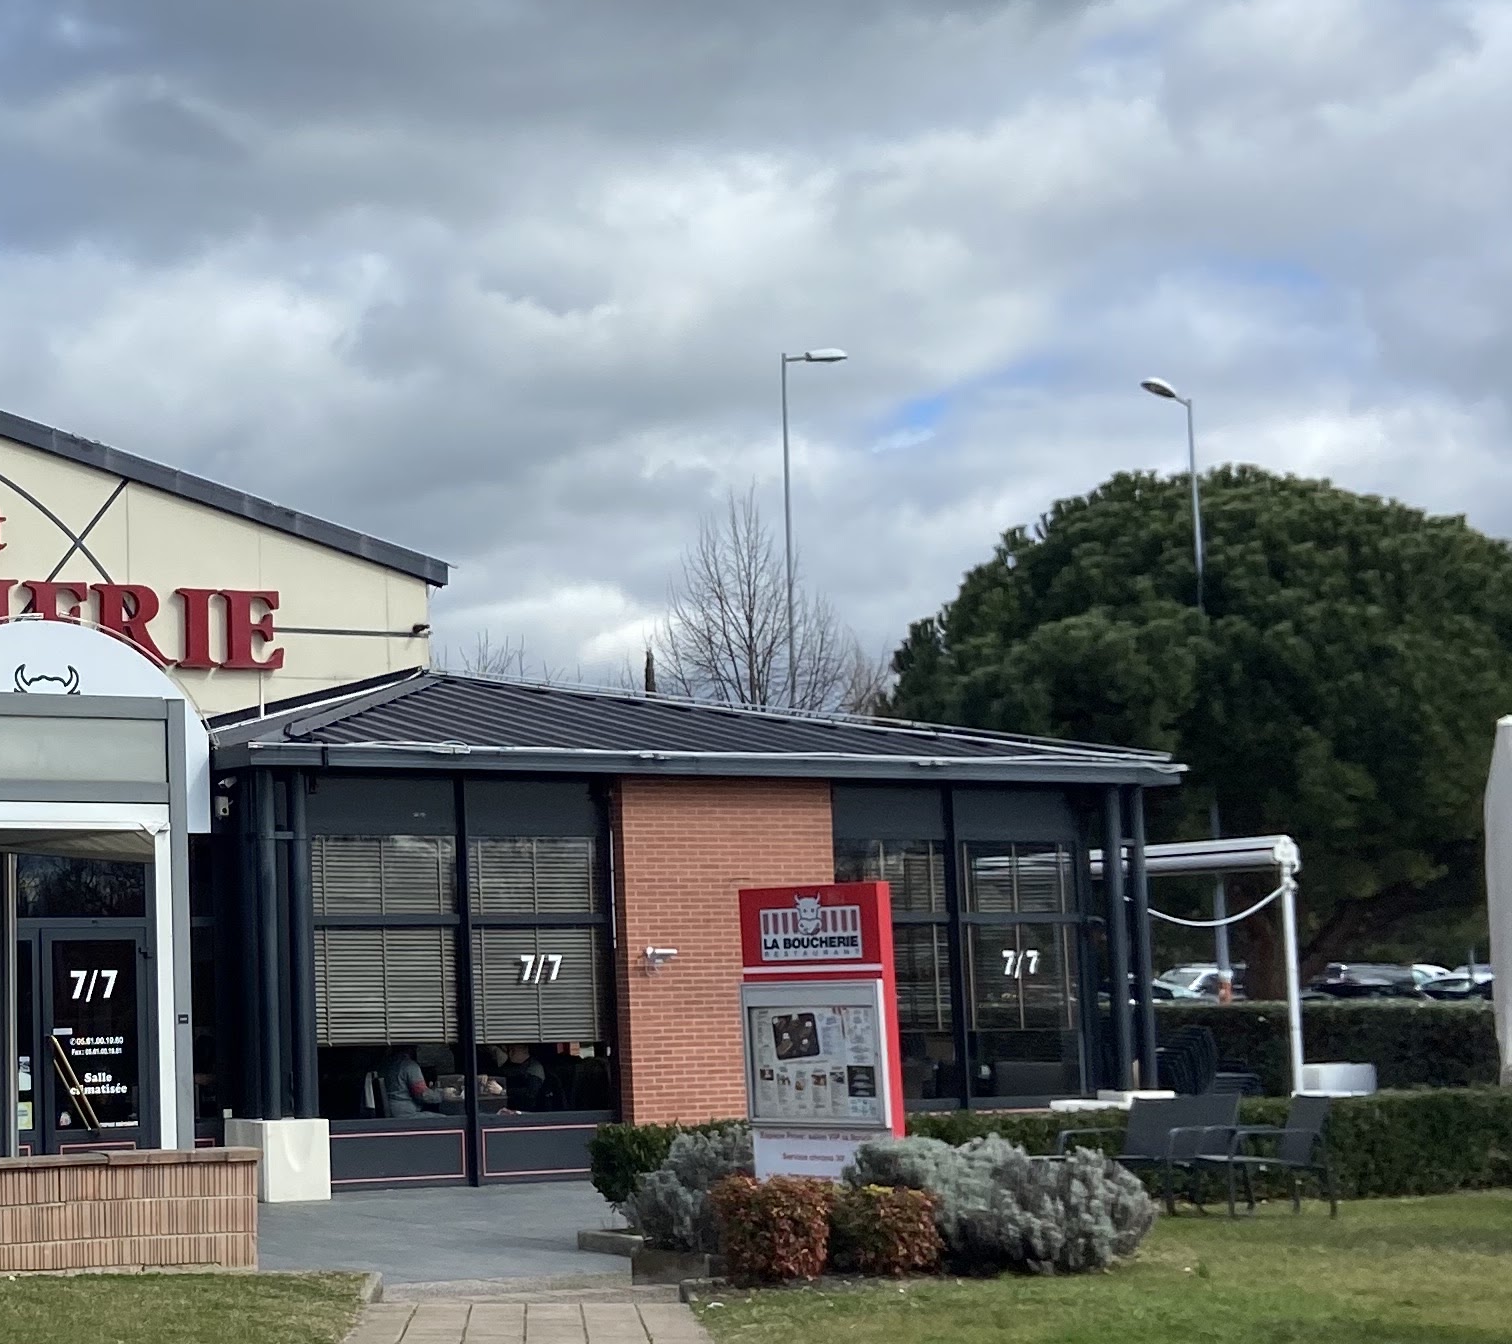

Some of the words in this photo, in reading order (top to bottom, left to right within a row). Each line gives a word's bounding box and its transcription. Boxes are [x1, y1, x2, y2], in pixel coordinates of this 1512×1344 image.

[763, 938, 780, 950] LA
[783, 935, 859, 949] BOUCHERIE
[764, 948, 860, 958] RESTAURANT
[520, 954, 563, 984] 7/7
[1001, 949, 1040, 979] 7/7
[70, 969, 118, 1003] 7/7
[83, 1072, 113, 1083] Salle
